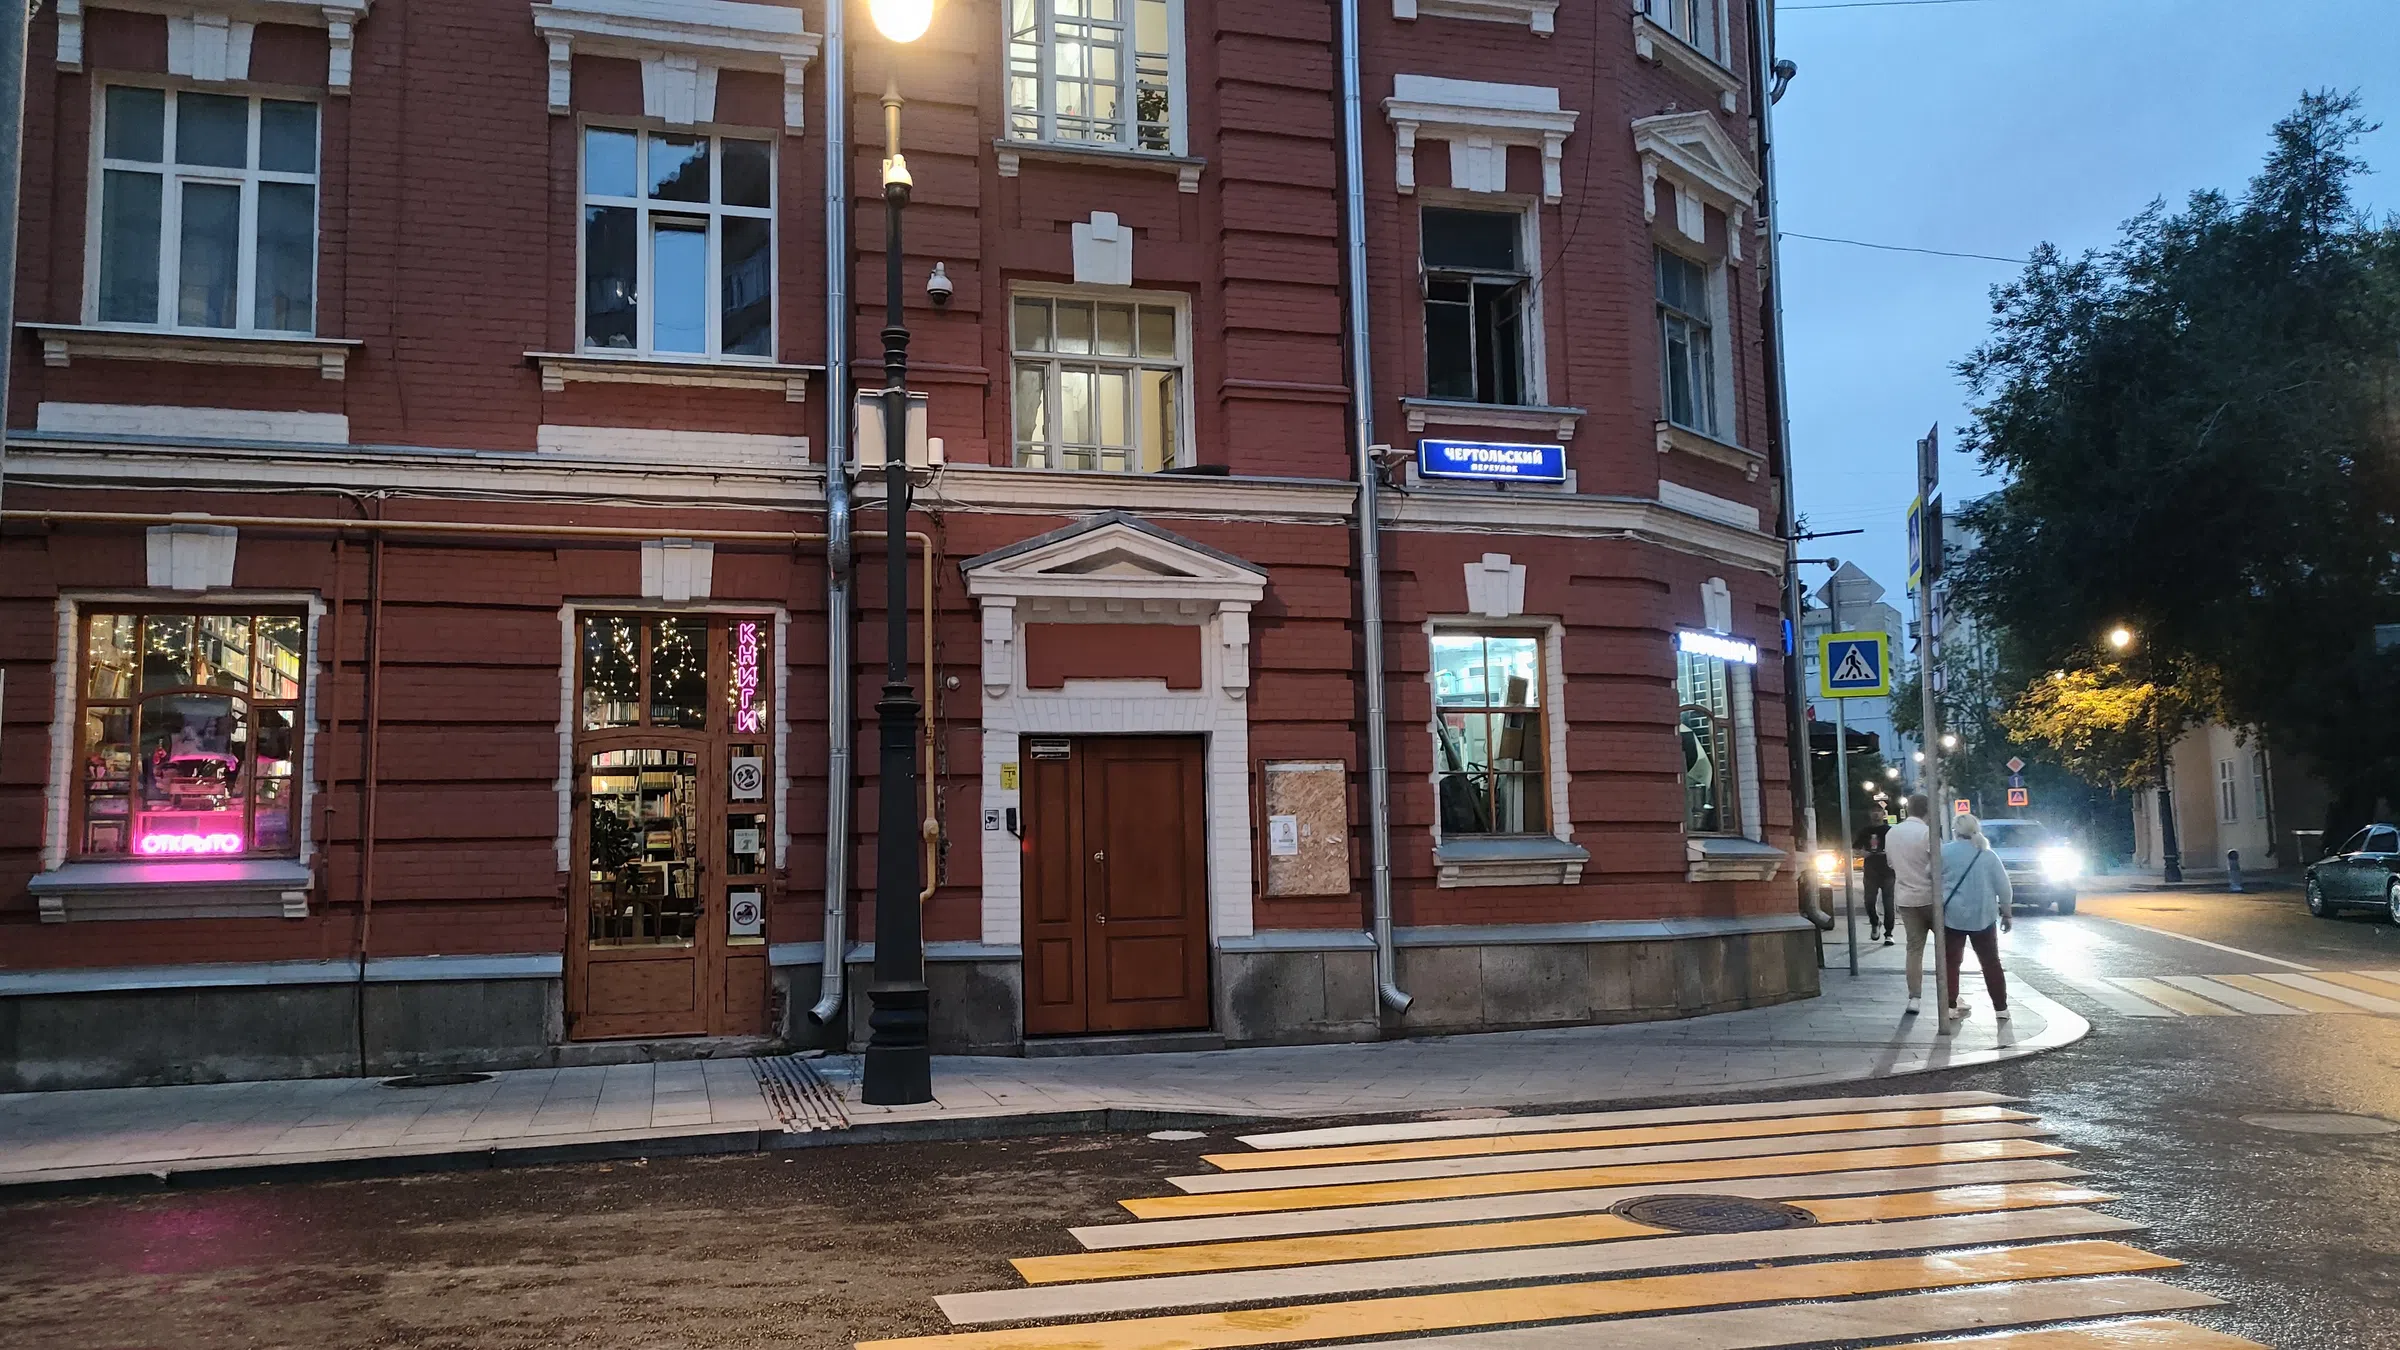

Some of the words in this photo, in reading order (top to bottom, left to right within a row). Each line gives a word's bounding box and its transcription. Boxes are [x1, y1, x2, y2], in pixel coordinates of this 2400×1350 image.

[1444, 447, 1543, 465] ЧЕРТОЛЬСКИЙ
[1470, 463, 1518, 473] ПЕРЕУЛОК
[738, 623, 757, 731] КНИГИ
[141, 833, 240, 854] ОТКРЫТО
